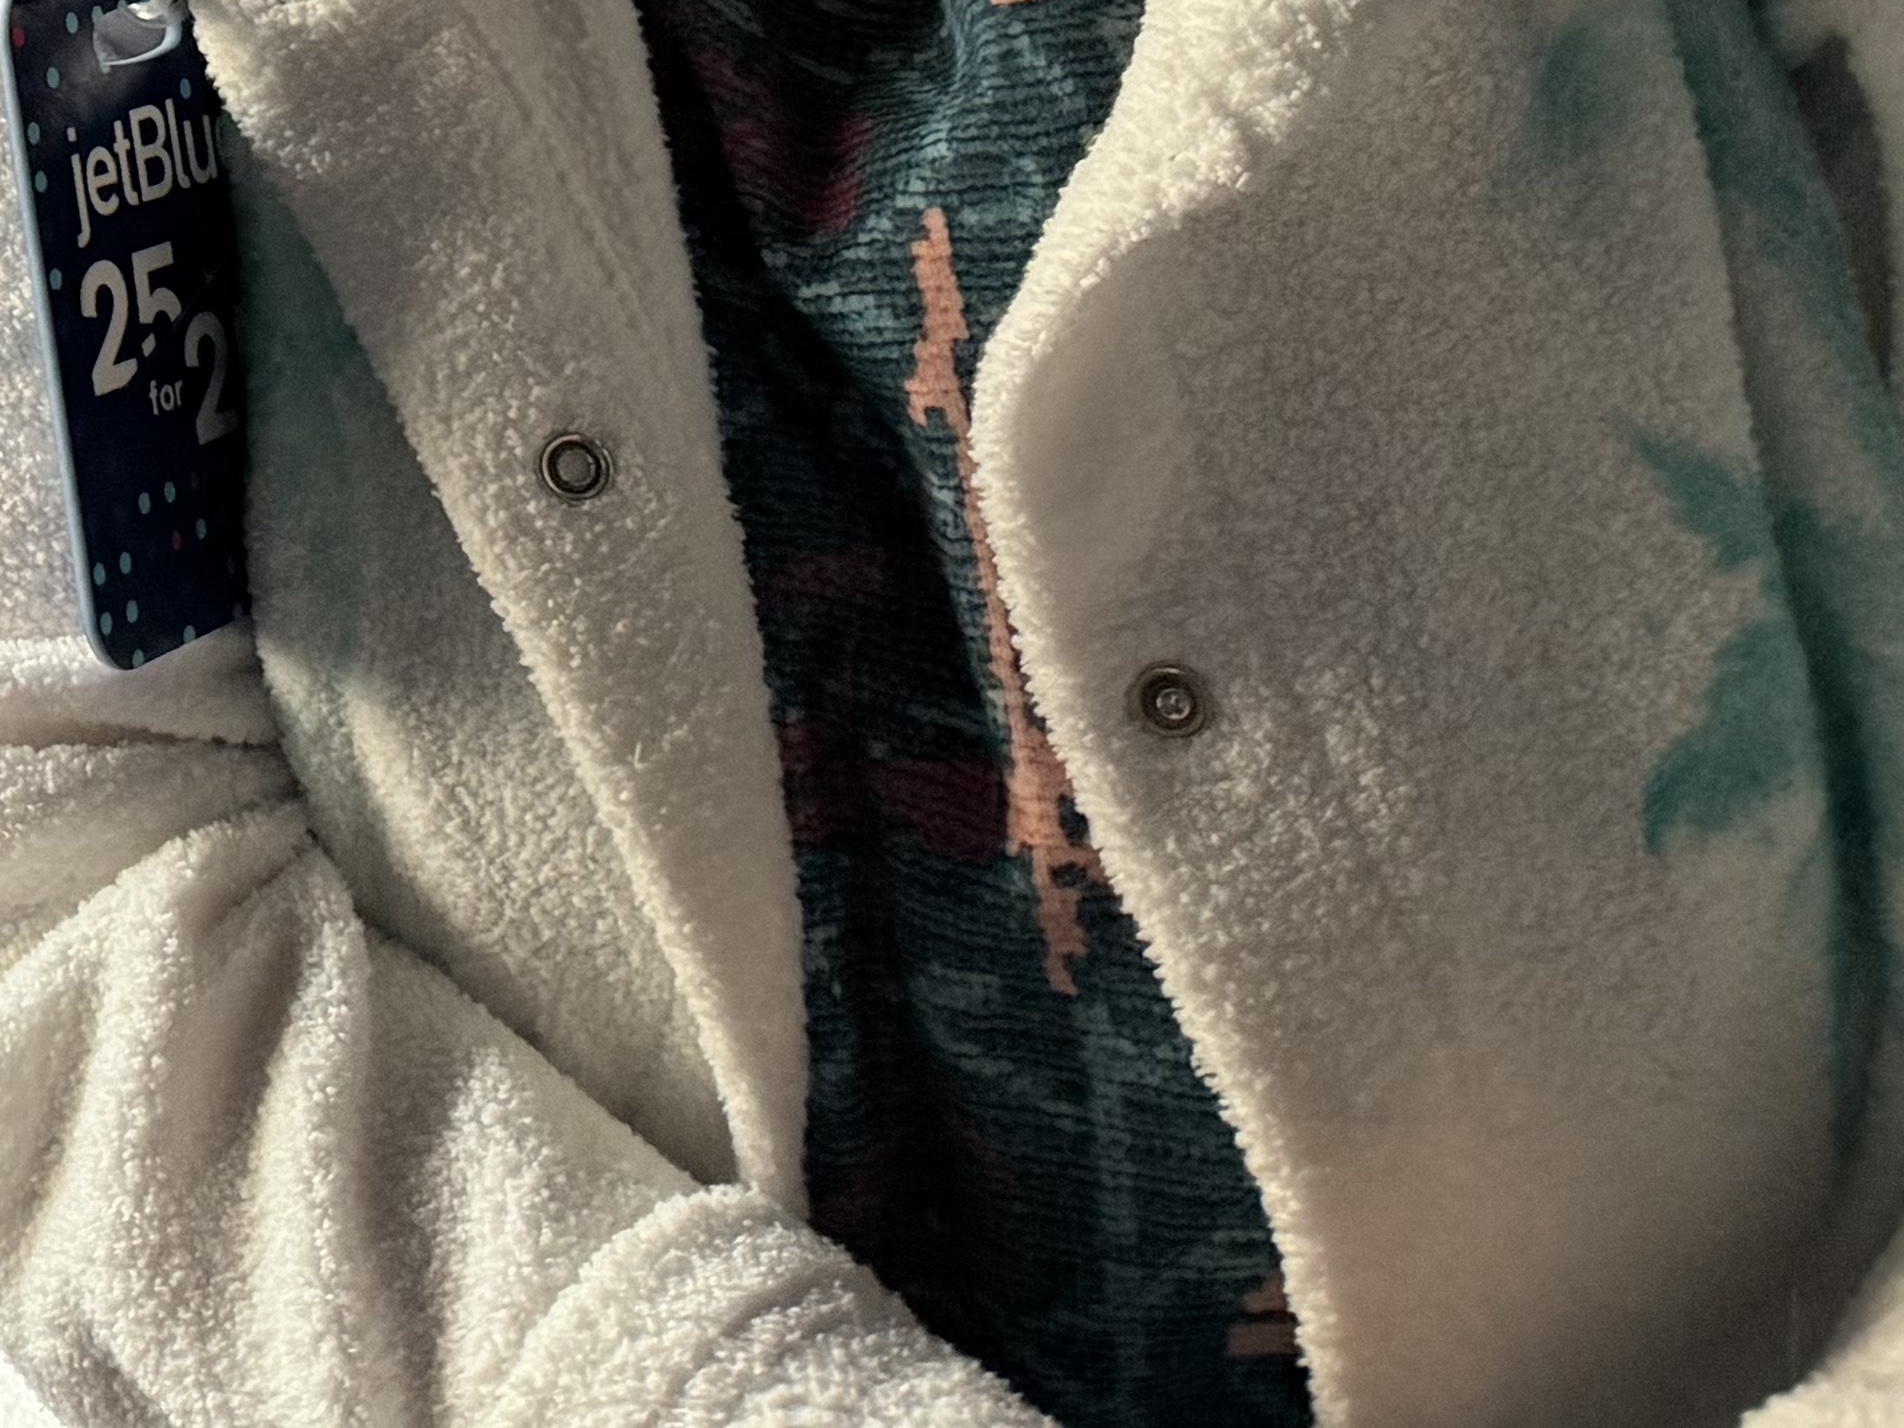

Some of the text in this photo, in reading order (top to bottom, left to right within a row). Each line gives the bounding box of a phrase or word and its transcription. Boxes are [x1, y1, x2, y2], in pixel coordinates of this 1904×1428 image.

[67, 96, 222, 249] jetBlu
[79, 240, 184, 397] 25
[148, 379, 184, 417] for
